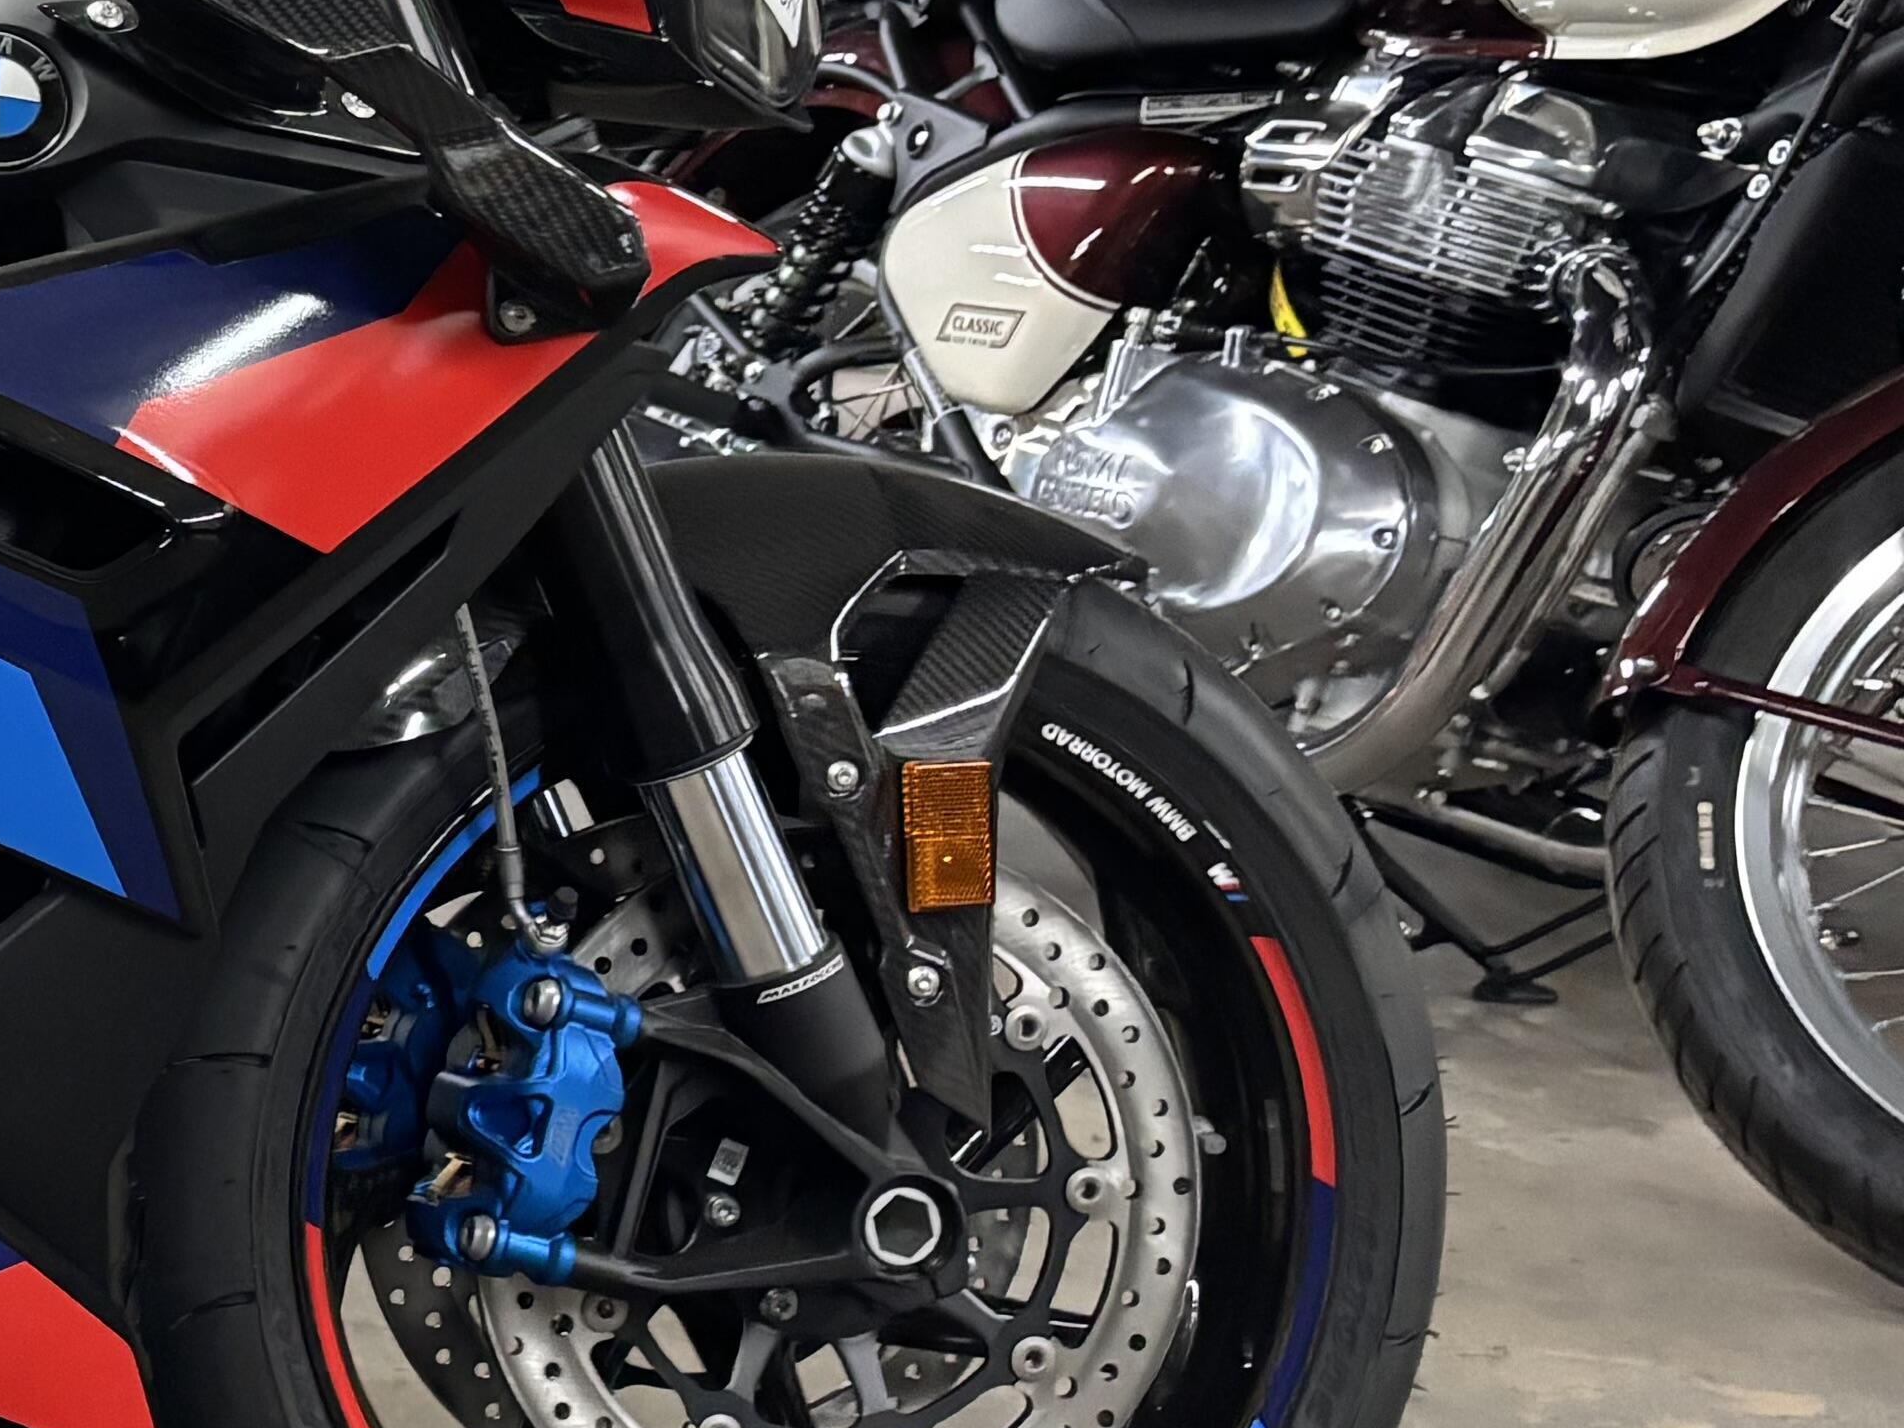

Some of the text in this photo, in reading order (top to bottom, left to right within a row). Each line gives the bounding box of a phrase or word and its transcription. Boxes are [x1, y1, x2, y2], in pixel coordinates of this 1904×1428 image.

[952, 315, 1004, 336] CLASSIC
[1040, 722, 1197, 842] BMW MOTORRAD
